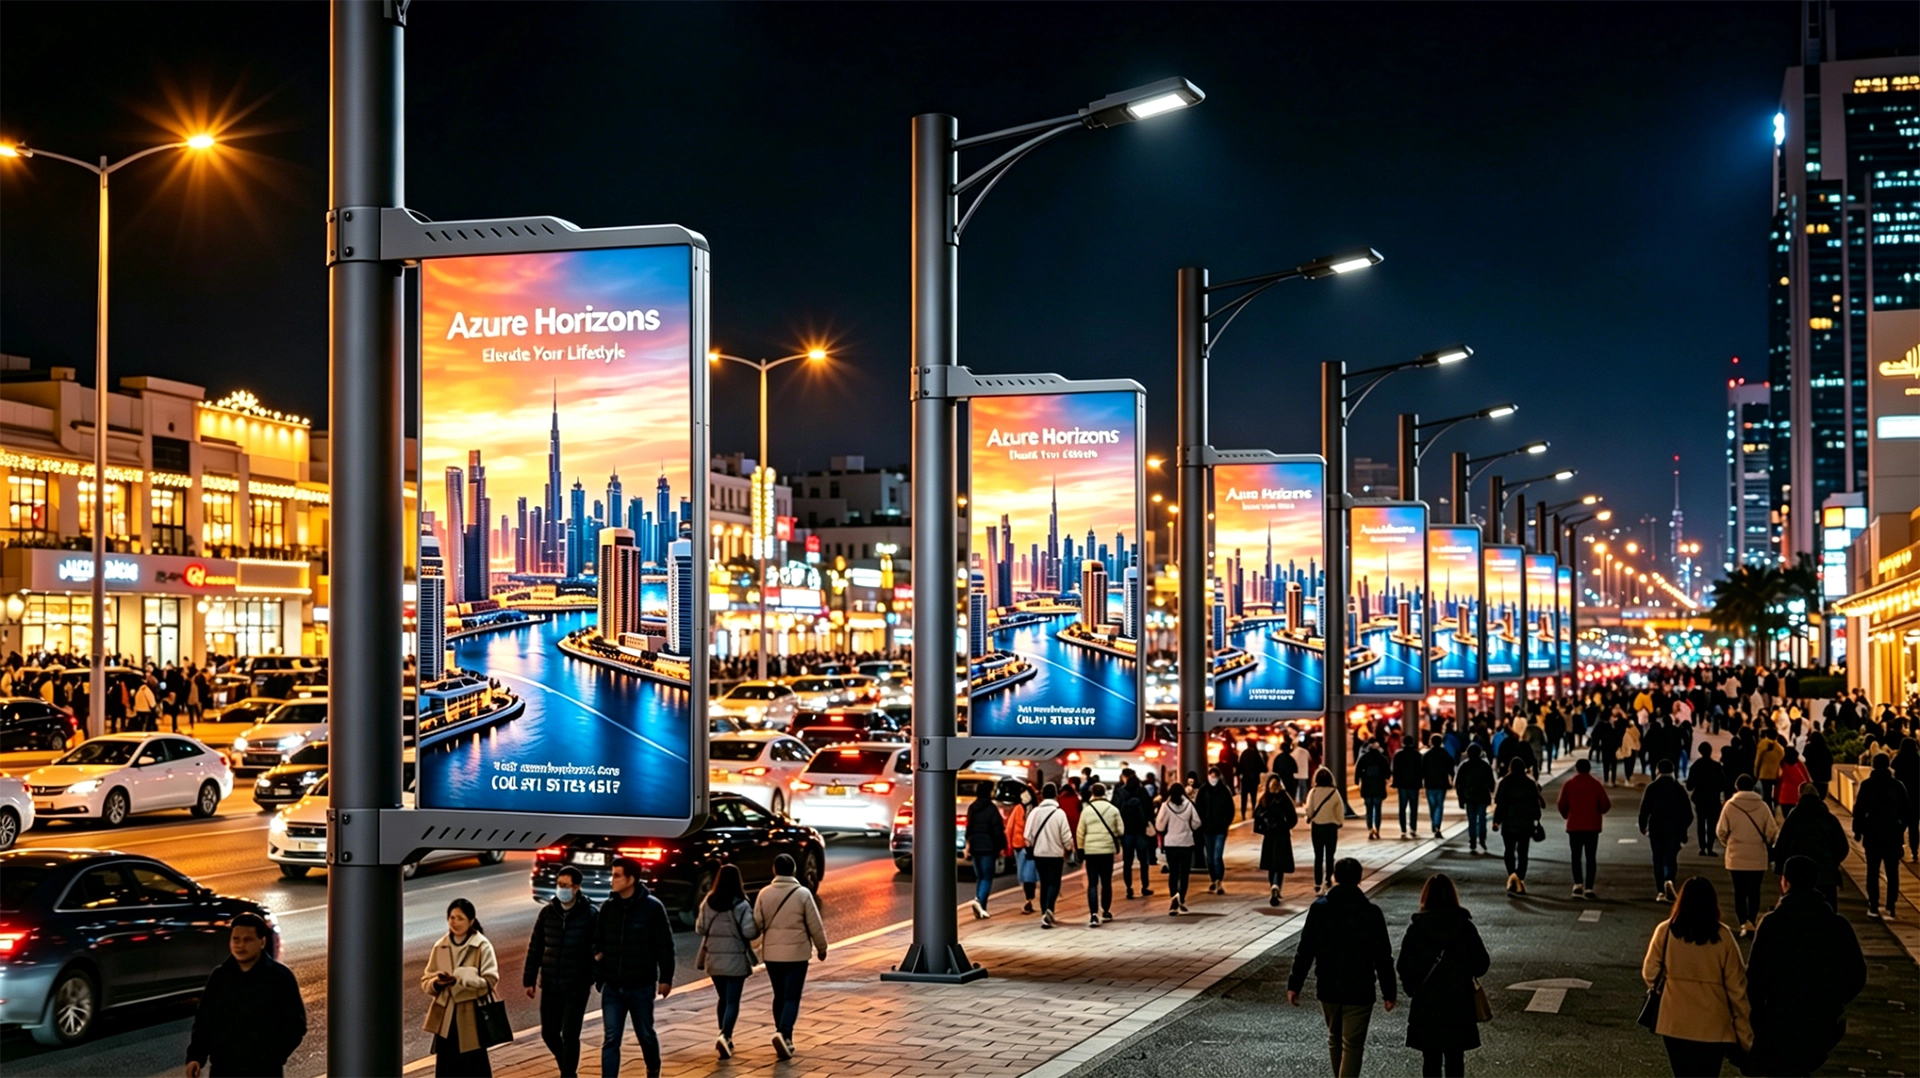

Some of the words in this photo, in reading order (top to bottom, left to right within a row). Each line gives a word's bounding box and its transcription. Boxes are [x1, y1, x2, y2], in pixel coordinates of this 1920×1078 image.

[446, 311, 529, 340] Azure
[535, 305, 661, 335] Horizons
[986, 428, 1039, 447] Azure
[1042, 426, 1120, 445] Horizons
